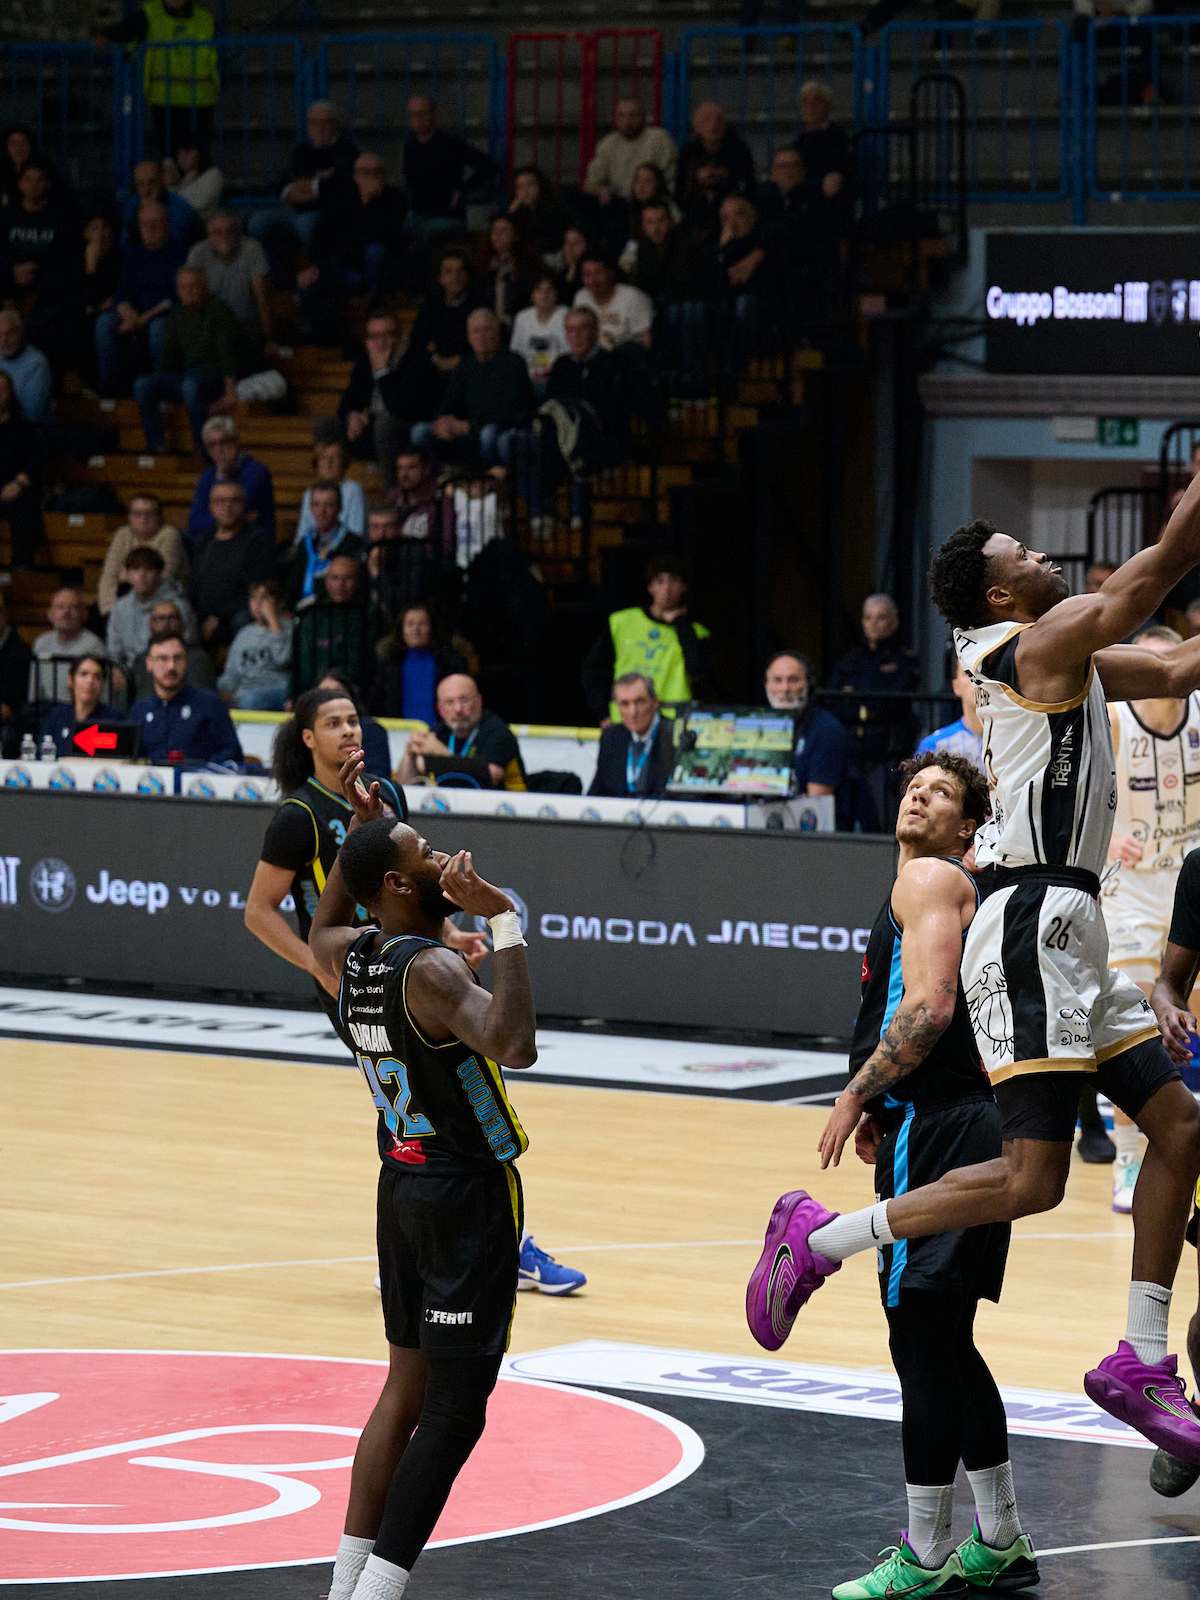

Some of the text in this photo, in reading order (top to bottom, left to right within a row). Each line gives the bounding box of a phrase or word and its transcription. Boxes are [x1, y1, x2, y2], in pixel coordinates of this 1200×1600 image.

[986, 285, 1051, 326] Gruppo
[1053, 283, 1122, 320] Bossoni
[1131, 736, 1149, 759] 22
[87, 870, 169, 915] Jeep
[541, 913, 696, 946] OMODA
[1045, 916, 1072, 951] 26
[356, 1051, 437, 1137] 42
[457, 1055, 518, 1163] CREMONA
[433, 1310, 473, 1325] FERVI
